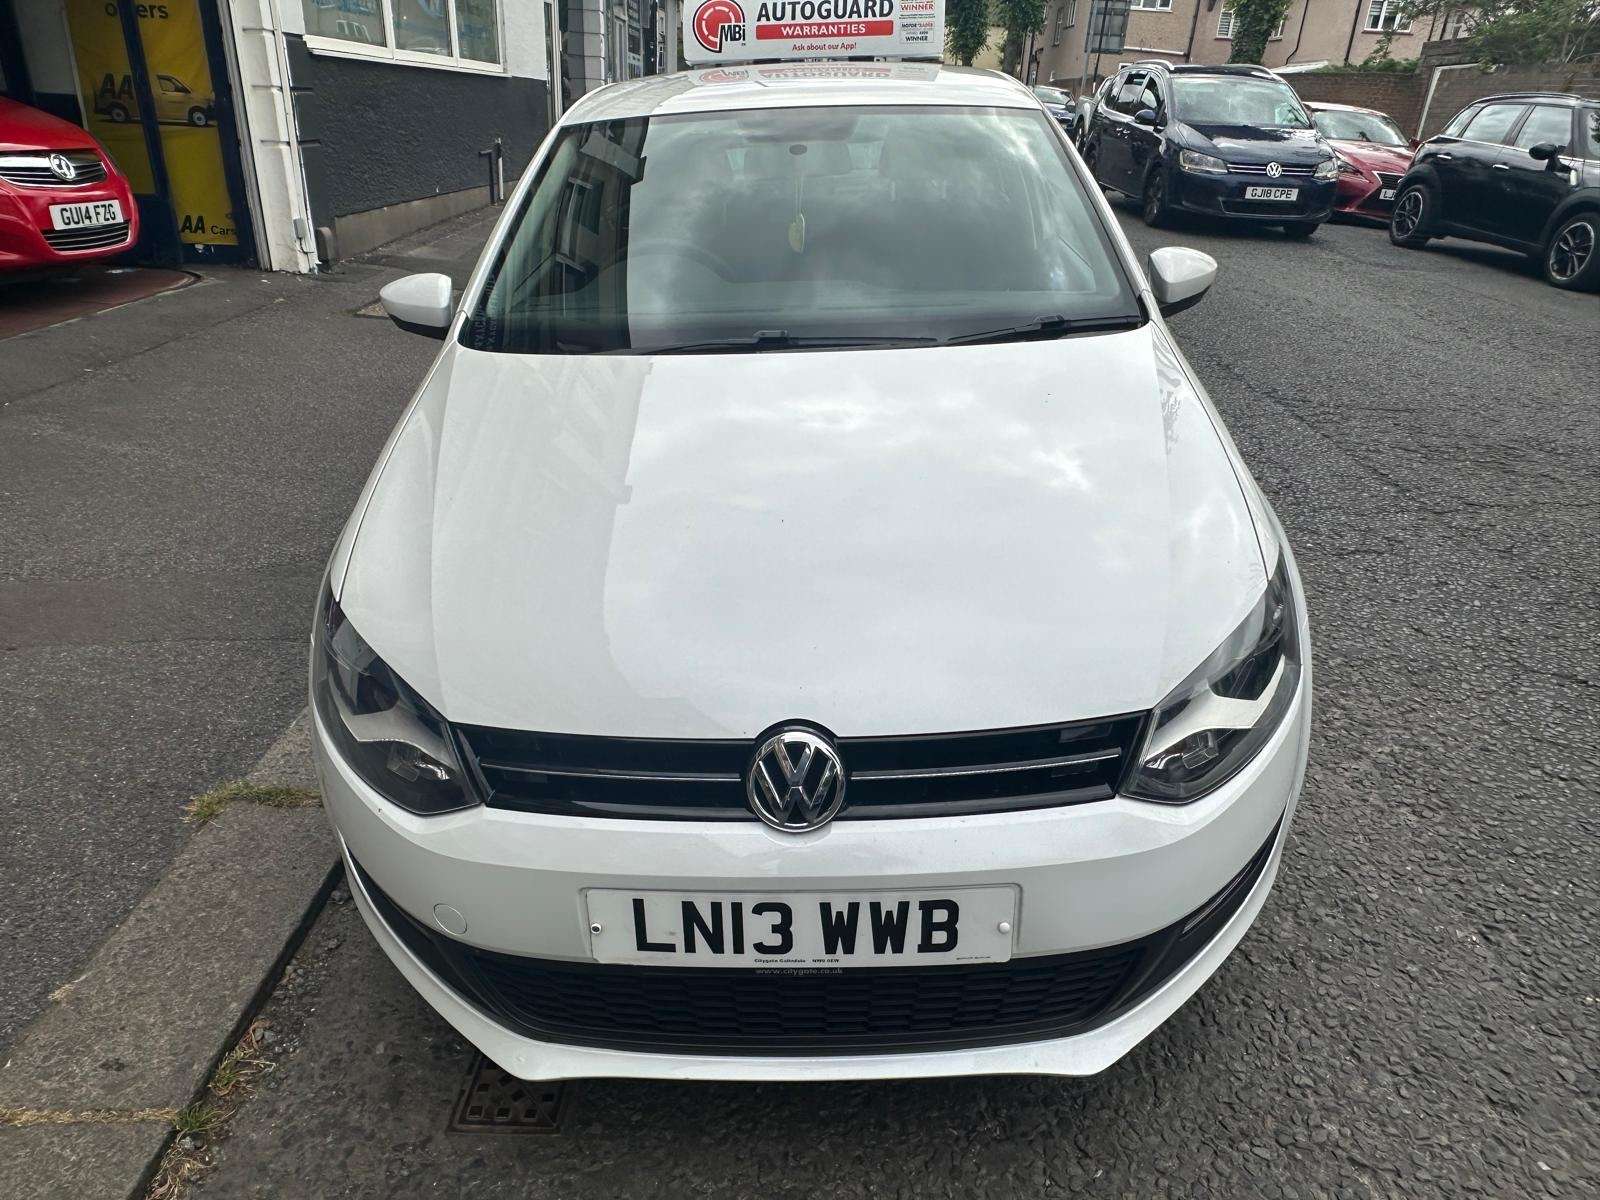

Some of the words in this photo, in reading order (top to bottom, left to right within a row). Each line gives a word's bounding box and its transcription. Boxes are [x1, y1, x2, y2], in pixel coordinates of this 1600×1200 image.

[104, 3, 169, 19] oers
[757, 0, 894, 22] AUTOGUARD
[781, 23, 866, 36] WARRANTIES
[807, 43, 826, 51] about
[840, 42, 857, 51] App!
[1251, 188, 1271, 198] GJ18
[1273, 189, 1293, 199] CPE
[60, 206, 92, 226] GU14
[93, 203, 116, 223] FZG
[181, 215, 205, 234] AA
[632, 898, 794, 955] LN13
[819, 899, 960, 955] WWB
